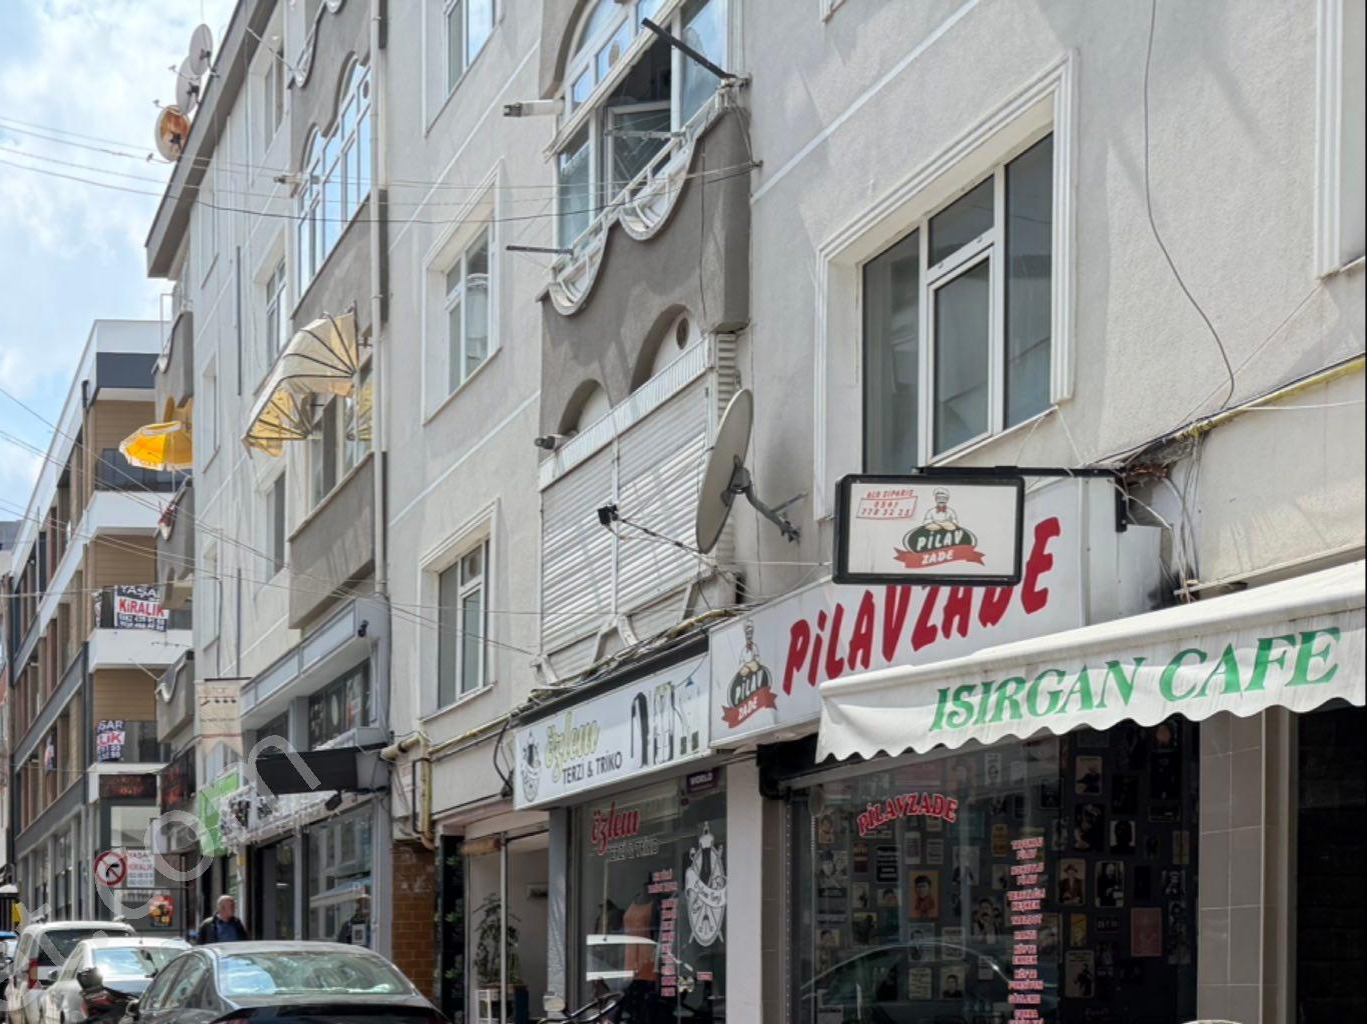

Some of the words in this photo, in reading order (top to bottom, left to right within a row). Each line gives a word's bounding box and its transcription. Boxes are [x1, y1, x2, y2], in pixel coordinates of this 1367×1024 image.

[916, 530, 964, 551] PİLAV
[921, 550, 955, 566] ZADE
[783, 516, 1062, 696] PİLAVZADE
[735, 668, 765, 706] PİLAV
[929, 656, 1147, 732] ISIRGAN
[1159, 626, 1341, 702] CAFE
[856, 792, 959, 836] PİLAVZADE
